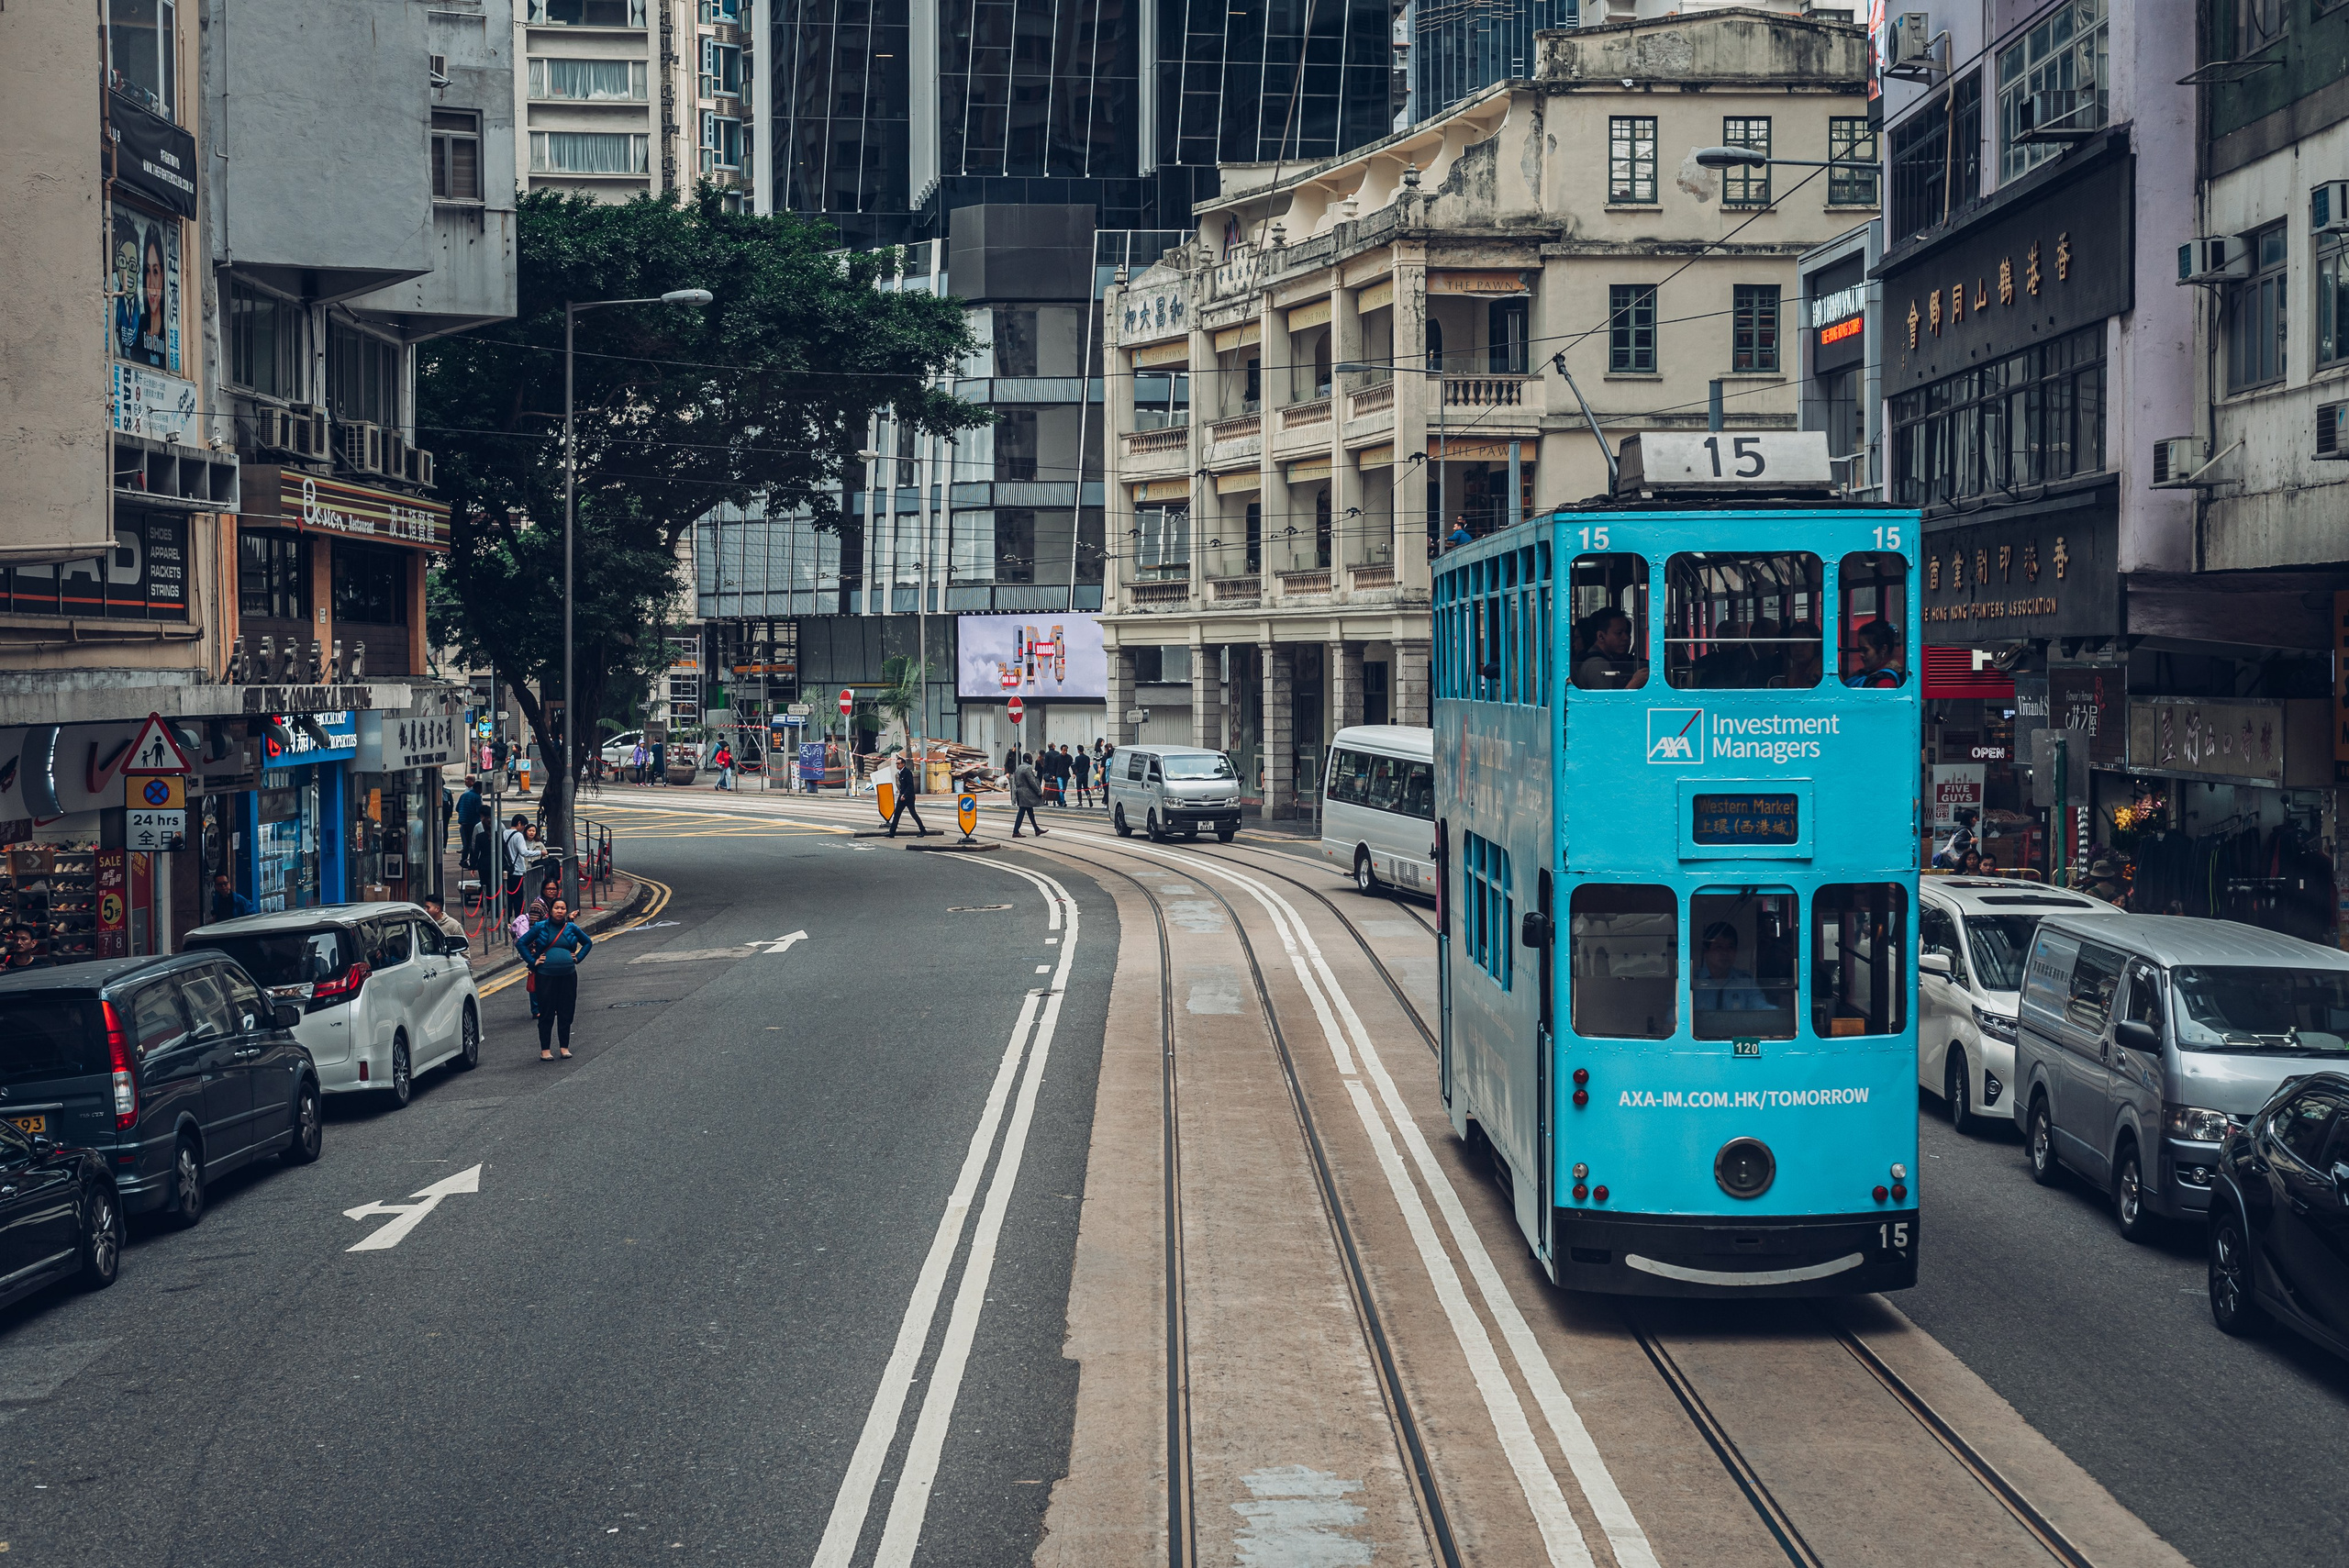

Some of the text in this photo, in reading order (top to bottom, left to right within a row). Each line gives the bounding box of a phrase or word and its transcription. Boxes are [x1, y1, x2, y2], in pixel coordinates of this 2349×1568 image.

[1447, 281, 1514, 291] THE PAWN
[1152, 349, 1183, 361] THE PAWN
[123, 367, 132, 431] BAFS
[1444, 446, 1471, 457] THE
[1703, 437, 1766, 478] 15
[1152, 486, 1184, 496] THE PAWN
[303, 478, 375, 535] Boston Restaurant
[388, 505, 435, 544] 波士頓餐廳
[150, 527, 173, 541] SHOES
[1578, 527, 1609, 550] 15
[1873, 526, 1901, 550] 15
[150, 546, 181, 561] APPAREL
[150, 564, 182, 579] RACKETS
[150, 584, 180, 597] STRINGS
[1932, 606, 1947, 621] HONG
[1950, 603, 1968, 620] KONG
[1971, 601, 2004, 619] PRINTERS
[2009, 596, 2057, 617] ASSOCIATION
[1712, 713, 1841, 735] Investment
[1649, 737, 1694, 758] AXA
[1712, 737, 1821, 764] Managers
[1972, 747, 2005, 759] OPEN
[1944, 784, 1970, 793] FIVE
[1941, 793, 1973, 803] GUYS
[1699, 799, 1796, 815] Western Market
[133, 815, 179, 826] 24 hrs
[138, 830, 173, 846] 全日
[99, 856, 121, 867] SALE
[1735, 1041, 1758, 1054] 120
[1619, 1087, 1870, 1110] AXA-IM.COM.HK/TOMORROW
[1879, 1222, 1909, 1249] 15
